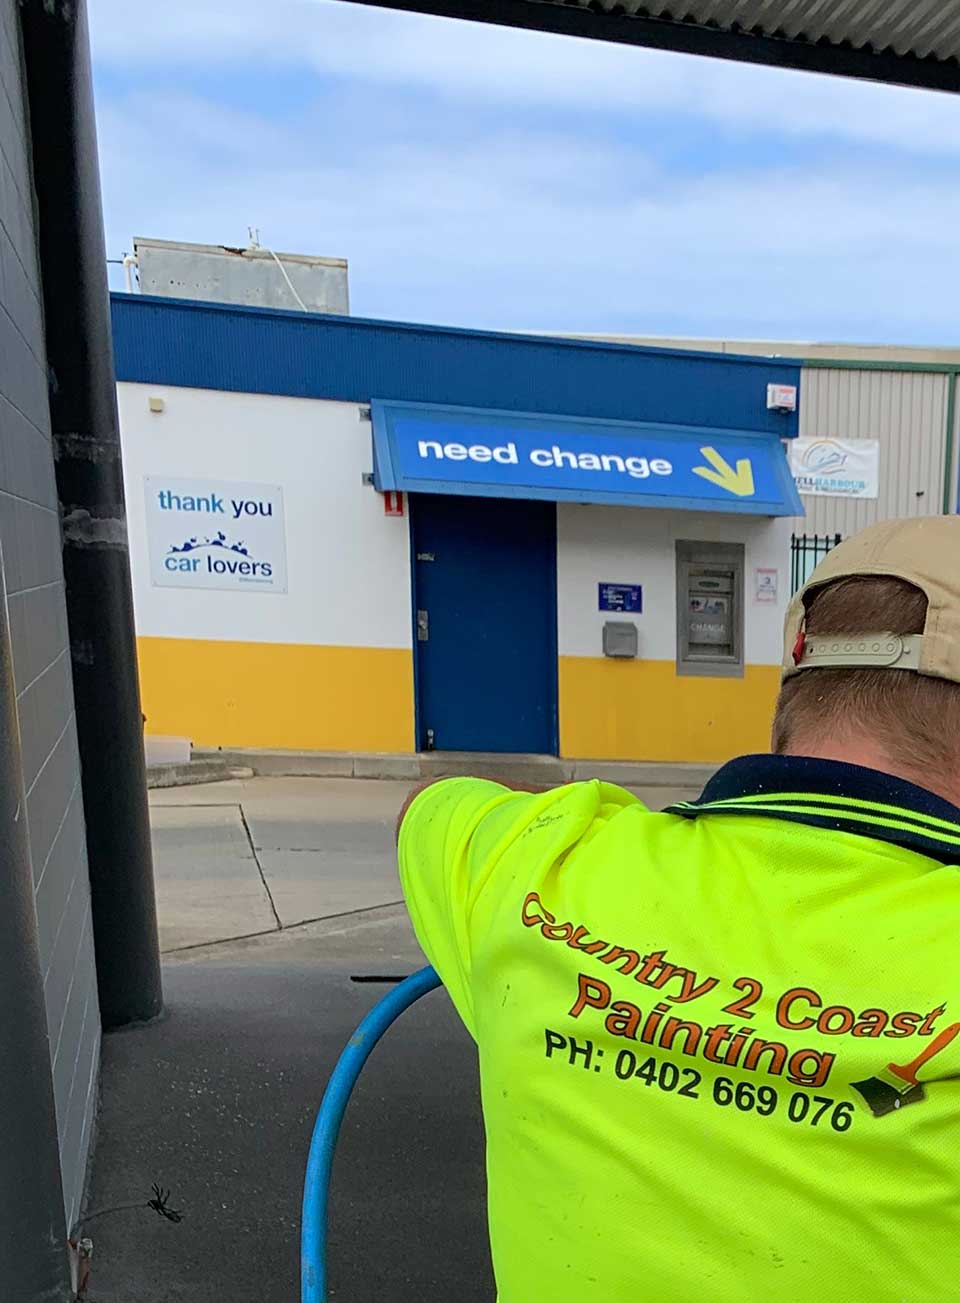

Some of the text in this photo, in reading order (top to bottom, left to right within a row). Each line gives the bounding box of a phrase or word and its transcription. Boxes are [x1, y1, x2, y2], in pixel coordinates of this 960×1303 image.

[418, 440, 673, 478] need change
[158, 490, 273, 519] thank you
[164, 554, 273, 577] car lovers
[521, 892, 947, 1038] Country 2 Coast
[568, 973, 837, 1088] Painting
[544, 1029, 856, 1132] PH: 0402 669 076
